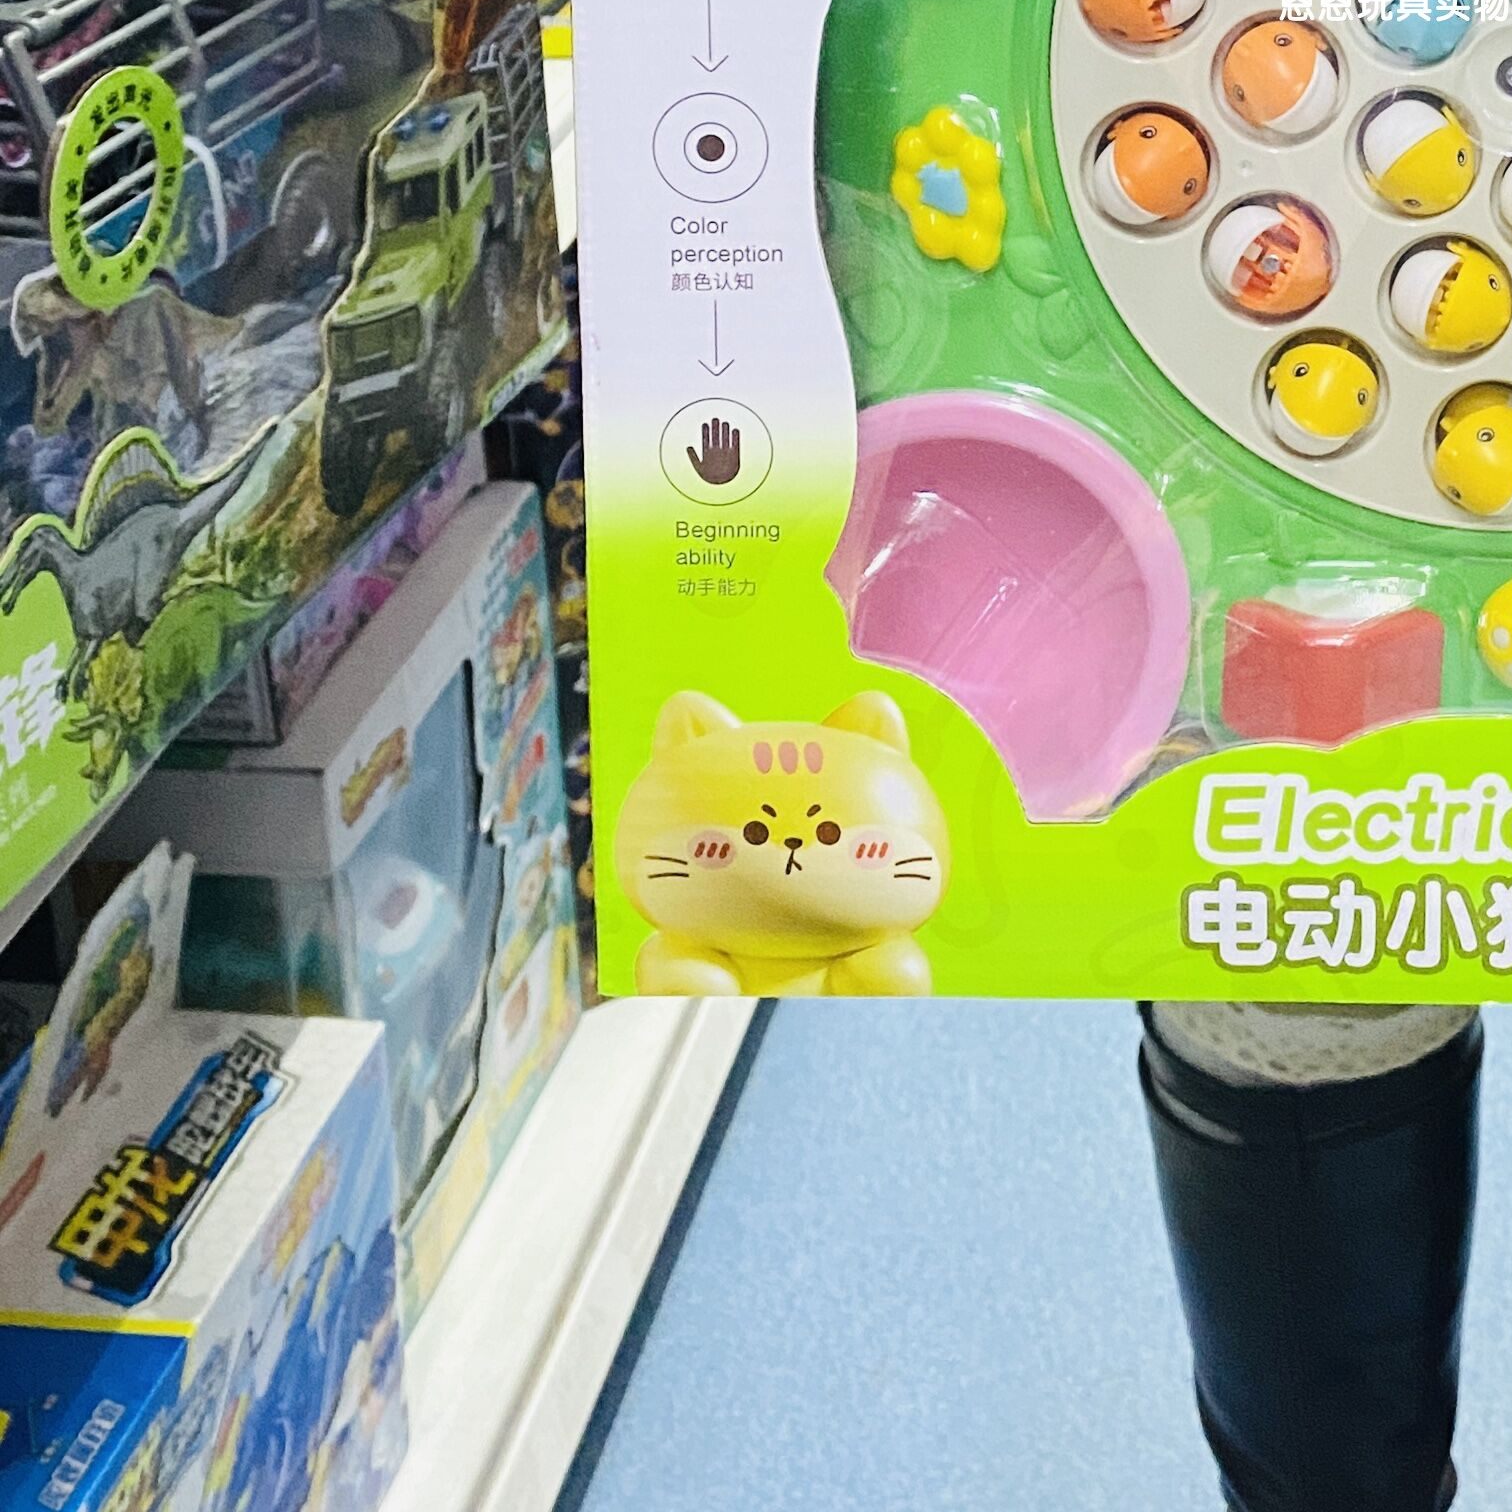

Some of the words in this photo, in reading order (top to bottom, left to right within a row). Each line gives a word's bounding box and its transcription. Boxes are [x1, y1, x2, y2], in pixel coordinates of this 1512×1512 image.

[669, 216, 729, 236] Color
[670, 244, 784, 266] perception
[671, 272, 754, 292] 颜色认知
[675, 520, 781, 544] Beginning
[675, 548, 737, 569] ability
[676, 577, 757, 598] 动手能力
